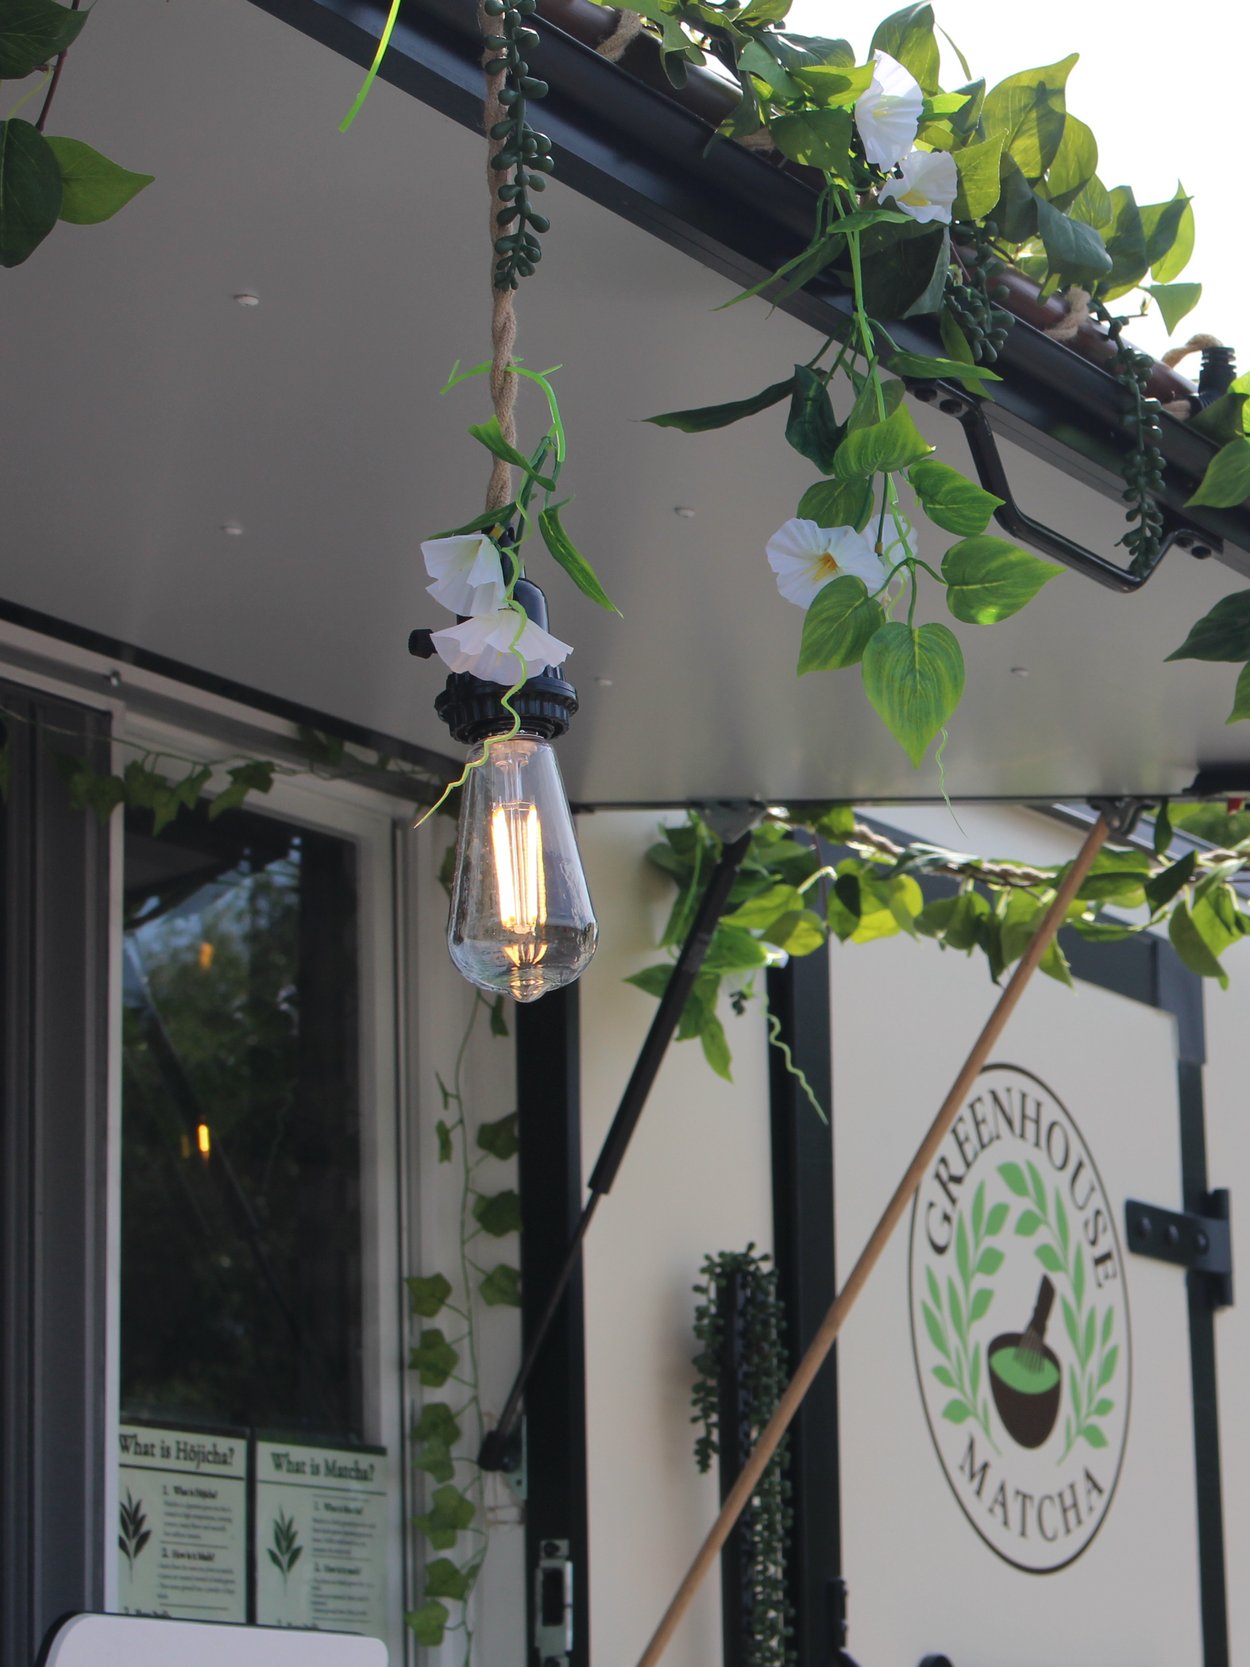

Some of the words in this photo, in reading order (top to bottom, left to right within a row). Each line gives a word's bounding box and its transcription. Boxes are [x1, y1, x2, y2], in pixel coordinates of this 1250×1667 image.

[924, 1088, 1118, 1289] GREENHOUSE
[119, 1433, 156, 1458] What
[160, 1440, 172, 1460] is
[270, 1451, 306, 1475] What
[310, 1457, 321, 1477] is
[324, 1458, 376, 1482] Matcha?
[959, 1433, 1104, 1542] MATCHA
